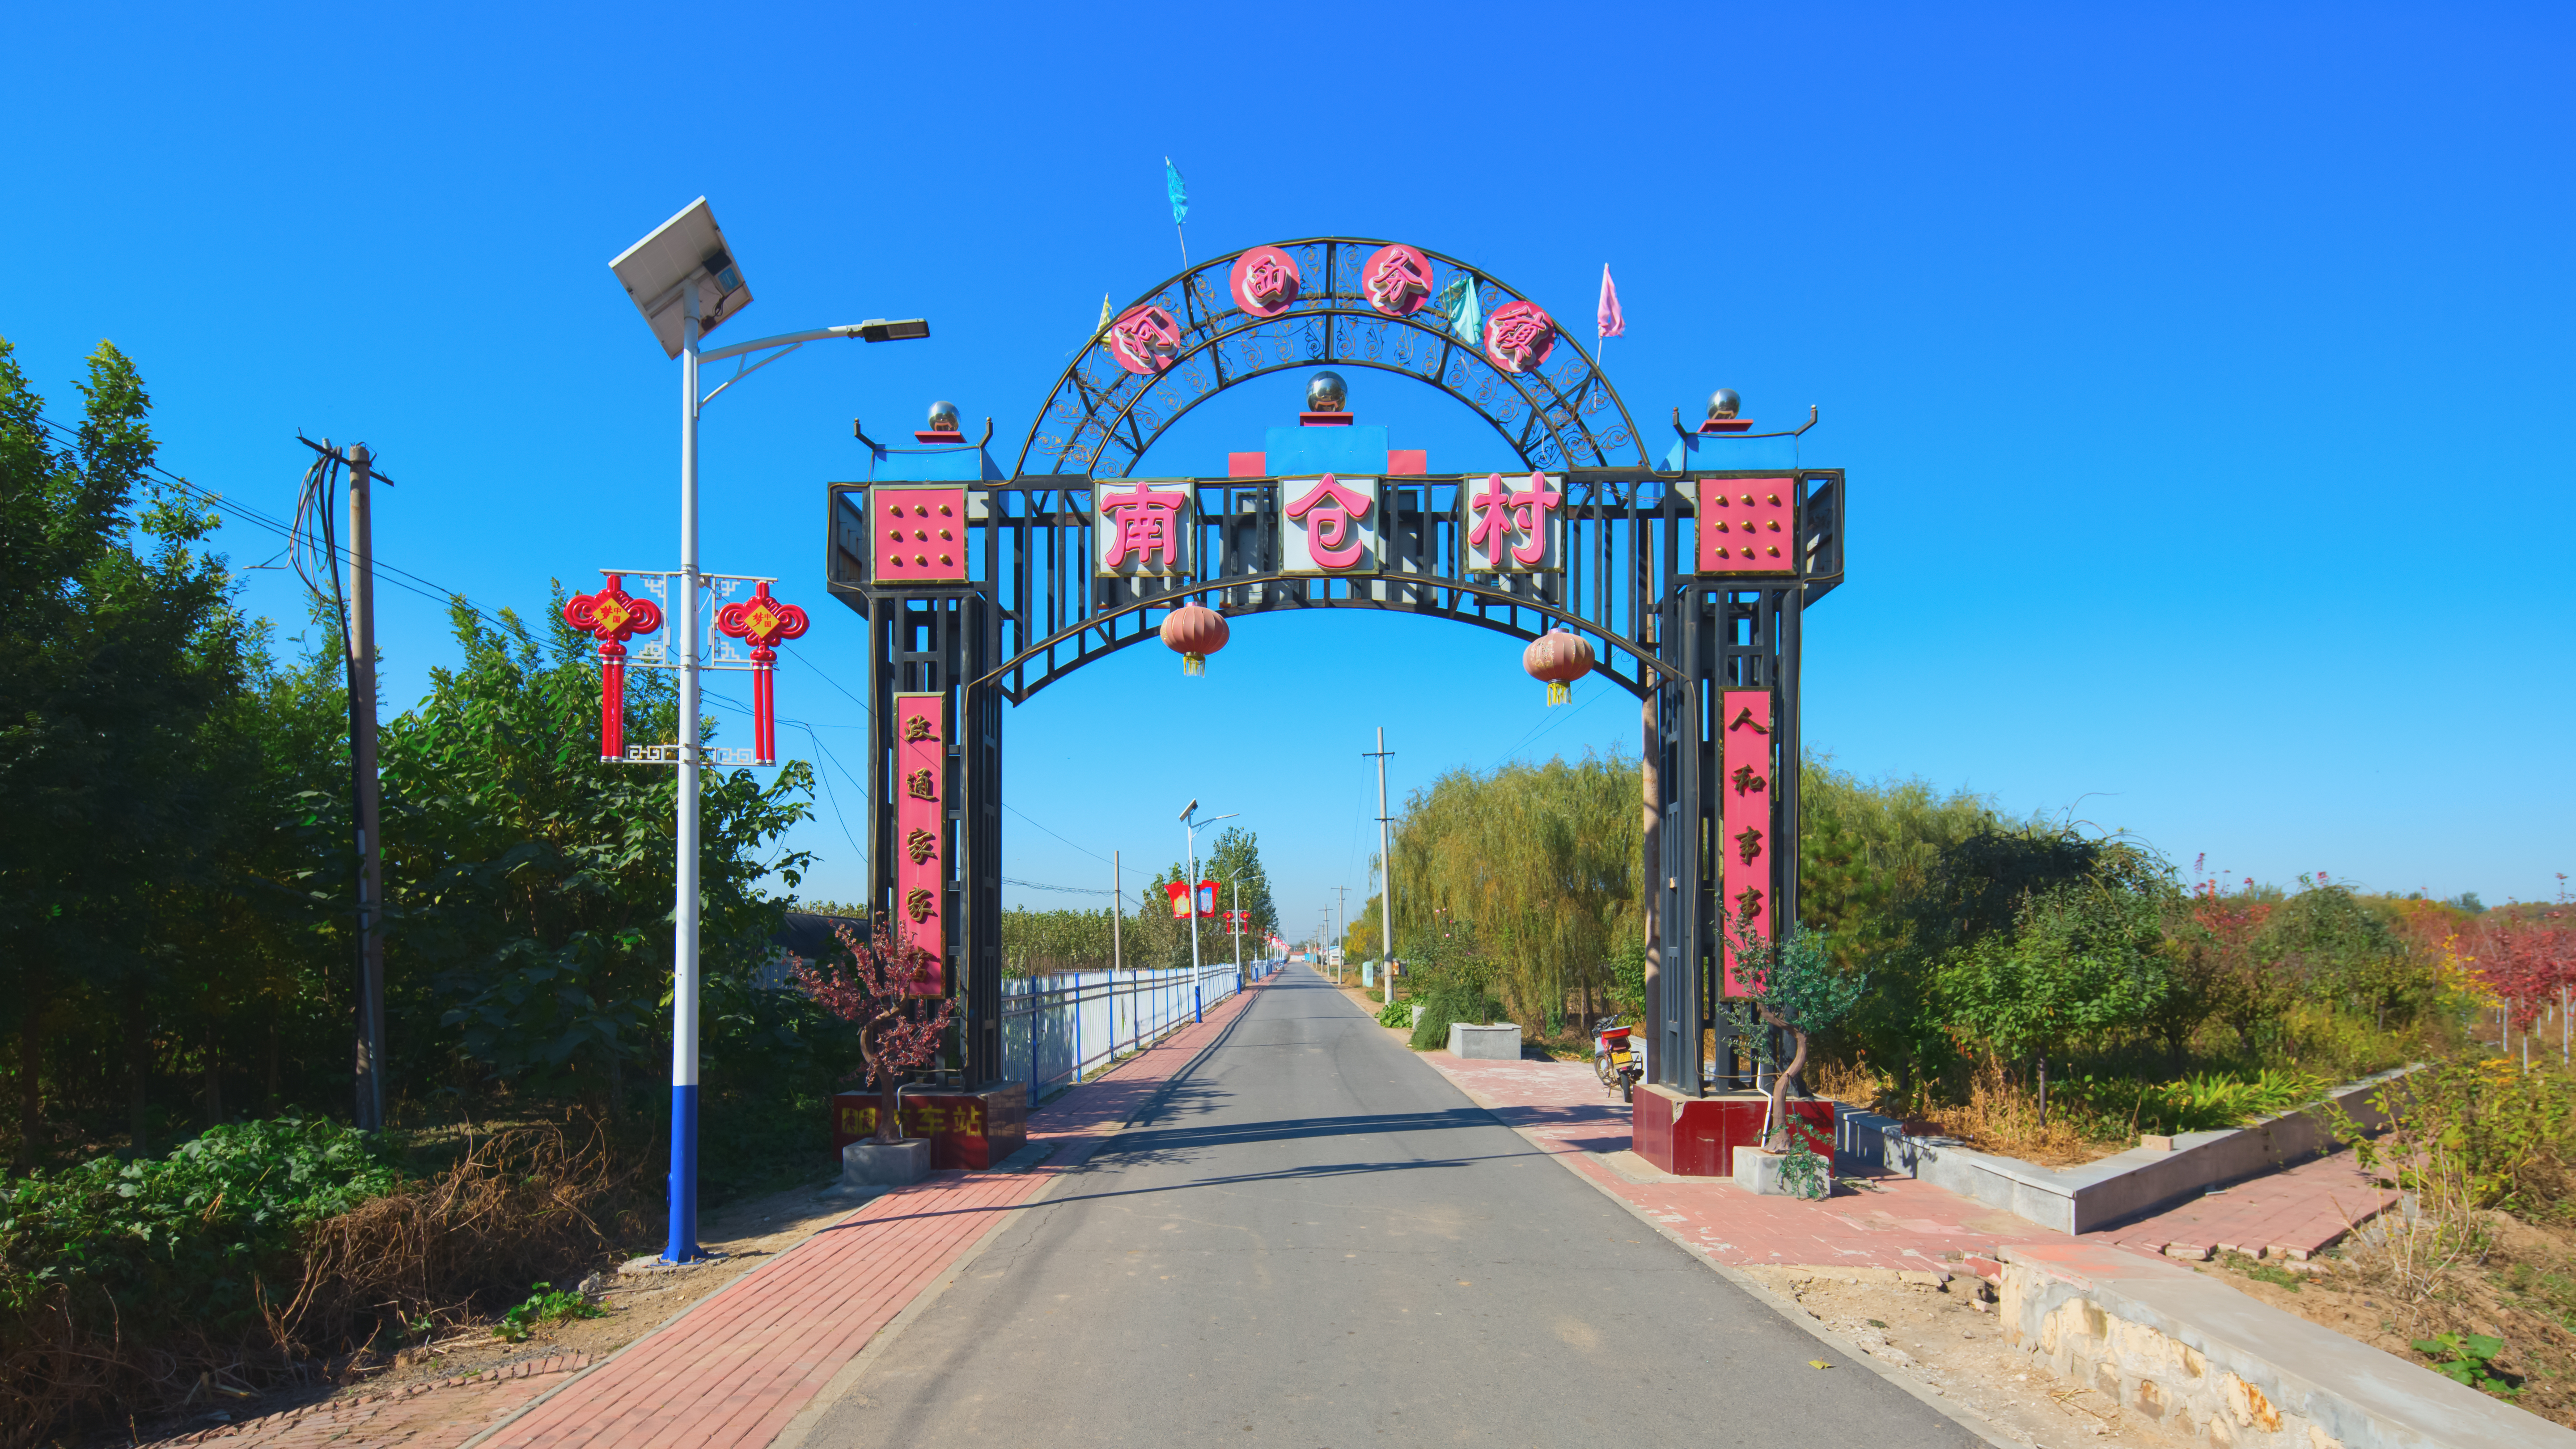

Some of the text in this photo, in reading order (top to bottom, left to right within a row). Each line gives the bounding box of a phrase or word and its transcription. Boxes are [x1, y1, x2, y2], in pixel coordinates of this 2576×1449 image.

[1119, 246, 1548, 367] 河西务镇
[1099, 471, 1563, 572] 南仓村
[1729, 707, 1768, 985] 人和事事
